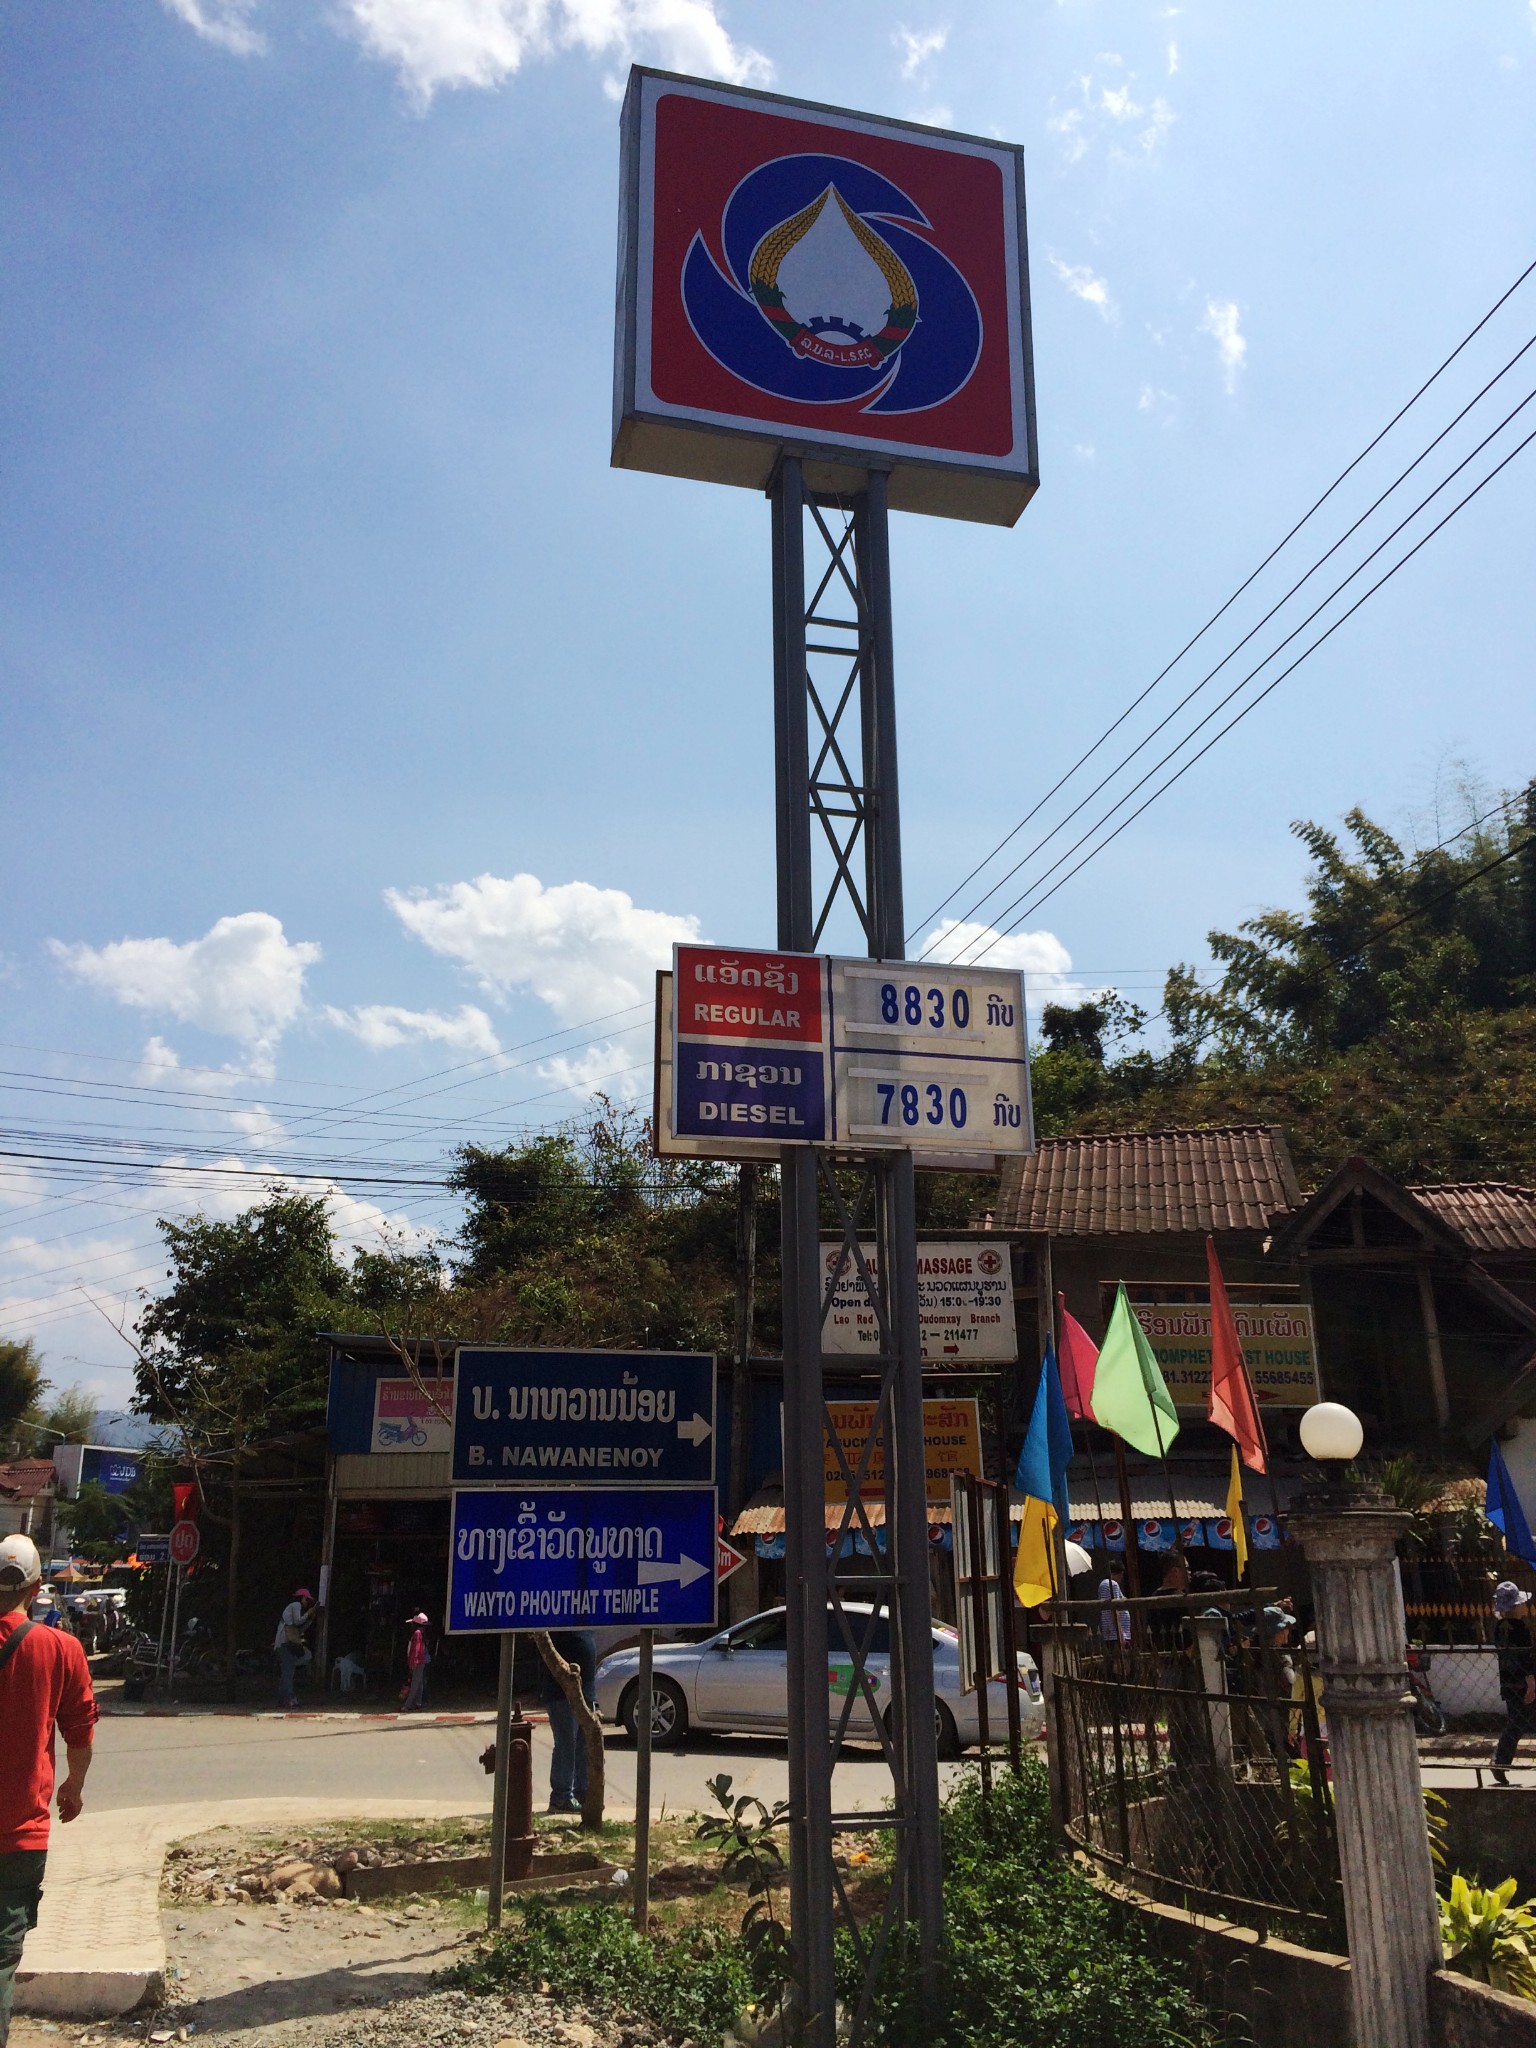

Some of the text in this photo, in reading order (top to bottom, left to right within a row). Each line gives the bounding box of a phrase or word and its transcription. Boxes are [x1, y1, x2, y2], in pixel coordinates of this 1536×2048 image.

[694, 1003, 800, 1029] REGULAR
[881, 983, 970, 1028] 8830
[699, 1101, 805, 1126] DIESEL
[877, 1083, 968, 1129] 7830
[831, 1296, 862, 1310] Open
[834, 1314, 849, 1325] Lao
[857, 1313, 874, 1325] Red
[970, 1313, 1001, 1324] Branch
[1265, 1350, 1310, 1366] HOUSE
[923, 1435, 967, 1446] HOUSE
[468, 1445, 664, 1468] B. NAWANENOY
[520, 1589, 598, 1616] PHOUTHAT
[603, 1588, 659, 1615] TEMPLE
